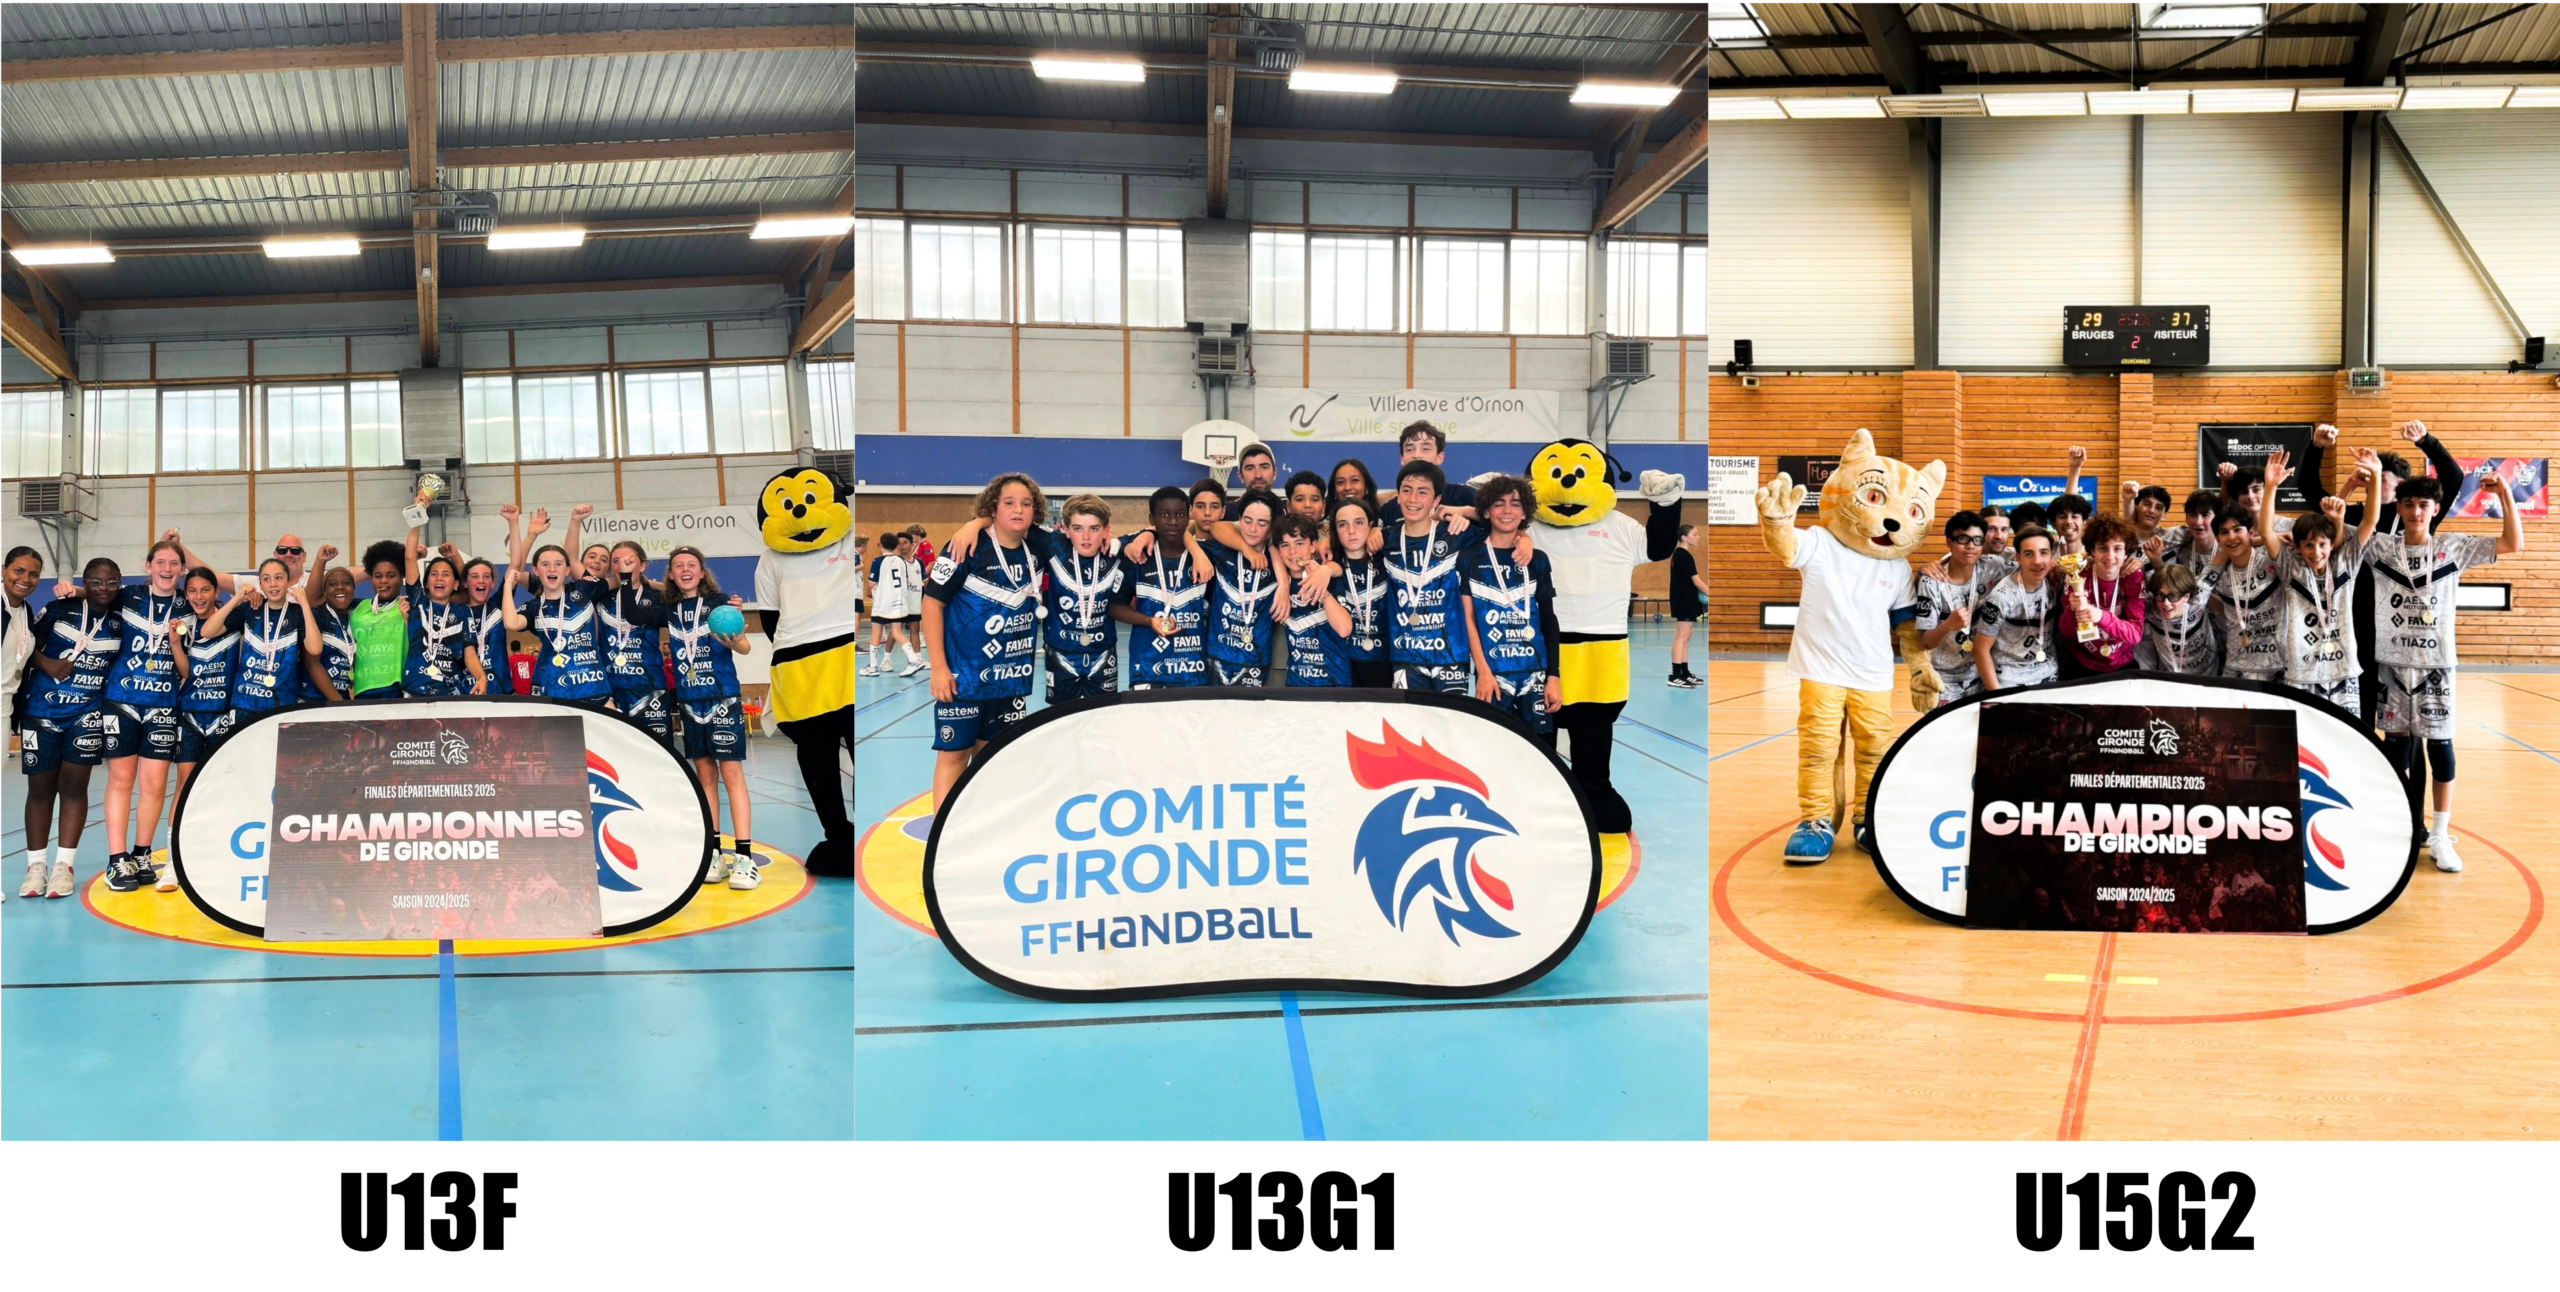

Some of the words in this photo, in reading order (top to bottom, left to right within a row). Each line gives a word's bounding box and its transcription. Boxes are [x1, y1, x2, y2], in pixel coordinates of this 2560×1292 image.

[2082, 312, 2102, 327] 29
[2172, 312, 2191, 326] 37
[2072, 330, 2115, 340] BRUGES
[2131, 336, 2140, 349] 2
[1369, 396, 1448, 412] Villenave
[1347, 419, 1382, 434] Ville
[1710, 460, 1756, 468] TOURISME
[1998, 484, 2018, 492] Chez
[582, 514, 659, 534] Villenave
[1412, 550, 1423, 568] 11
[892, 568, 902, 588] 5
[684, 610, 694, 622] 10
[1418, 612, 1445, 626] AYAT
[1003, 622, 1032, 634] MUTUELLE
[1006, 636, 1034, 653] FAYAT
[1404, 637, 1446, 650] TIAZO
[2246, 644, 2276, 654] TIAZO
[2400, 637, 2437, 648] TIAZO
[1498, 646, 1534, 658] TIAZO
[613, 666, 645, 675] TIAZO
[992, 662, 1016, 670] groupe
[993, 664, 1032, 680] TIAZO
[1165, 660, 1205, 674] TIAZO
[73, 674, 104, 686] FAYAT
[569, 670, 604, 685] TIAZO
[686, 676, 716, 688] TIAZO
[133, 680, 172, 692] TIAZO
[246, 686, 273, 698] TIAZO
[2421, 688, 2450, 696] SDBG
[198, 690, 226, 700] TIAZO
[152, 716, 176, 724] SDBG
[645, 710, 667, 718] SDBG
[713, 717, 735, 725] SDBG
[2104, 728, 2146, 738] COMITÉ
[397, 740, 436, 750] COMITÉ
[2097, 738, 2146, 746] GIRONDE
[390, 749, 436, 758] GIRONDE
[2070, 774, 2104, 788] FINALES
[2104, 770, 2182, 789] DÉPARTEMENTALES
[2183, 776, 2205, 790] 2025
[364, 785, 397, 799] FINALES
[398, 782, 474, 798] DÉPARTEMENTALES
[474, 784, 496, 797] 2025
[1055, 775, 1307, 842] COMITÉ
[279, 810, 585, 842] CHAMPIONNES
[1981, 800, 2294, 841] CHAMPIONS
[2064, 832, 2096, 853] DE
[2099, 833, 2207, 855] GIRONDE
[360, 841, 392, 862] DE
[394, 840, 499, 861] GIRONDE
[1003, 838, 1309, 904] GIRONDE
[2096, 887, 2128, 902] SAISON
[2128, 887, 2176, 903] 2024/2025
[392, 895, 423, 909] SAISON
[424, 894, 470, 910] 2024/2025
